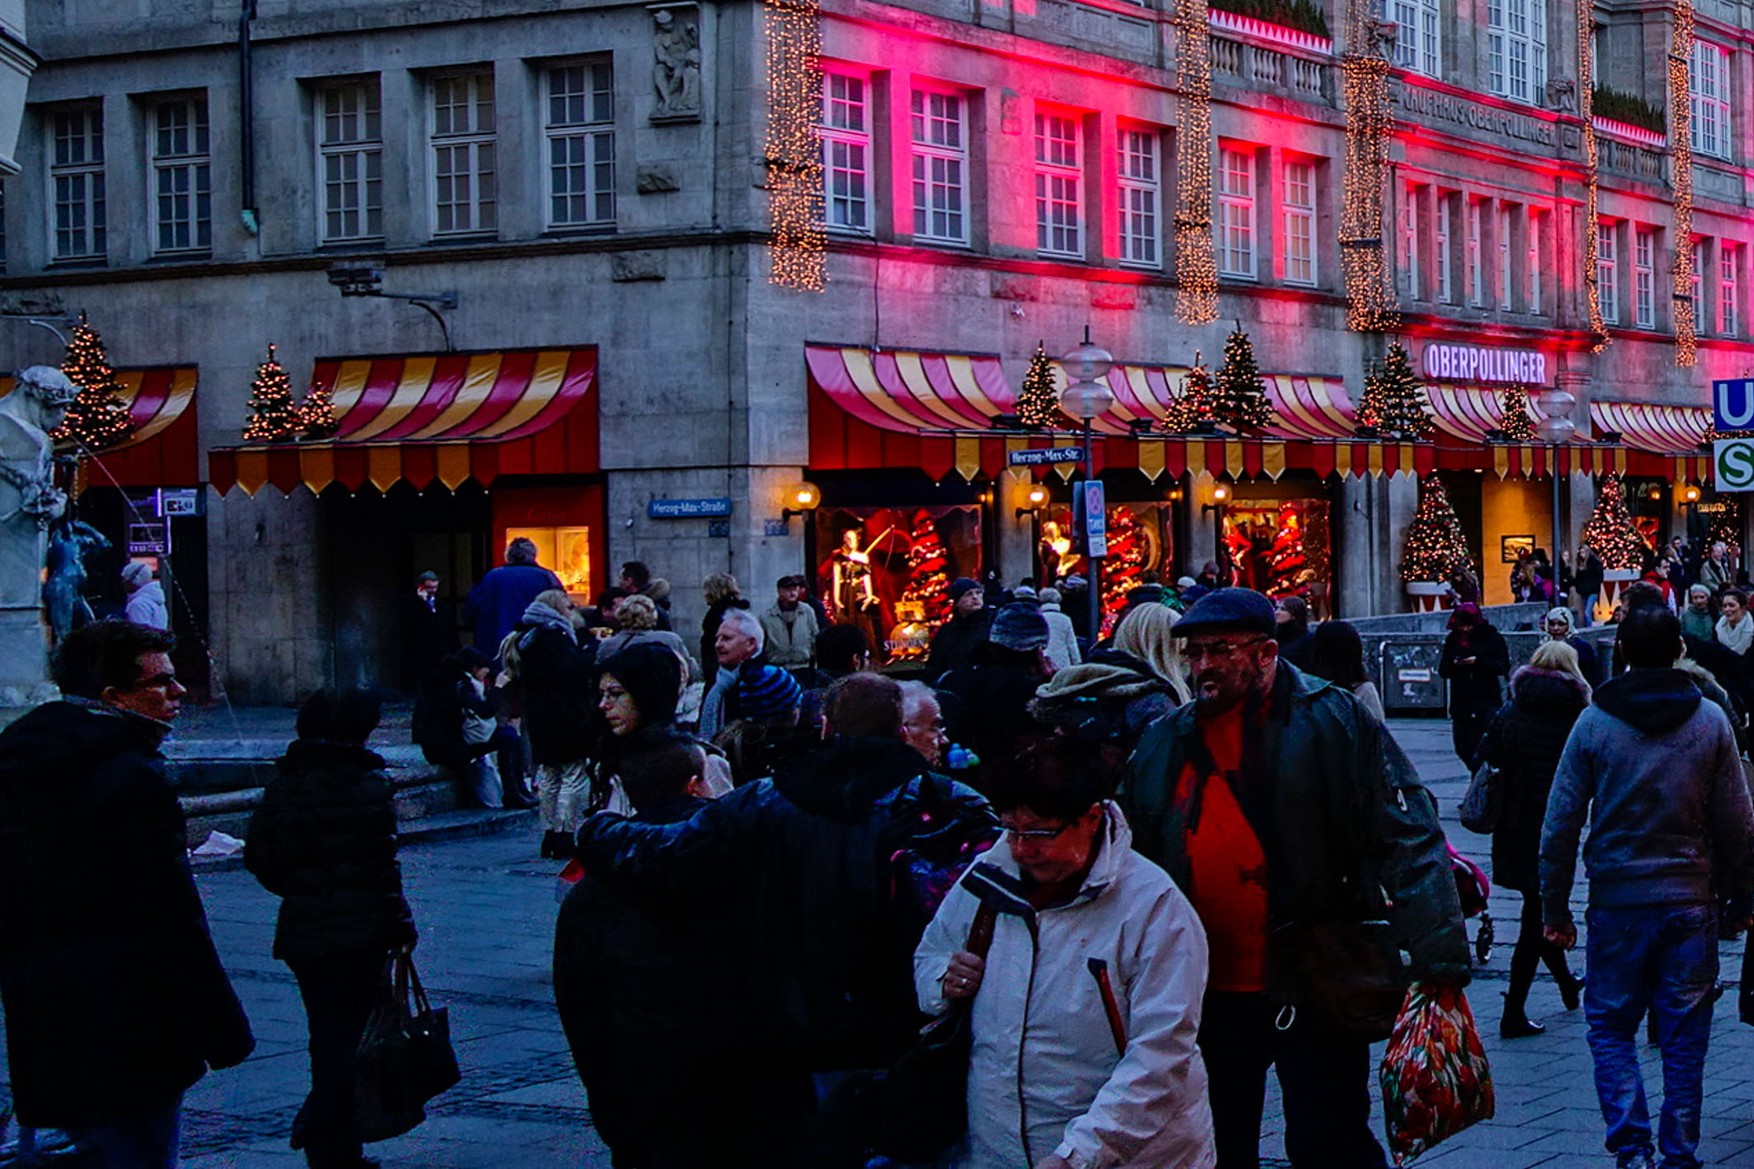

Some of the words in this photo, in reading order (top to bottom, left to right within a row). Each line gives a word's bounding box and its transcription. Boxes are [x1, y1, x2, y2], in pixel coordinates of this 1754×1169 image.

[1429, 344, 1546, 384] OBERPOLLINGER
[1012, 448, 1080, 464] Herzog-Max-Str.
[1725, 445, 1754, 484] S
